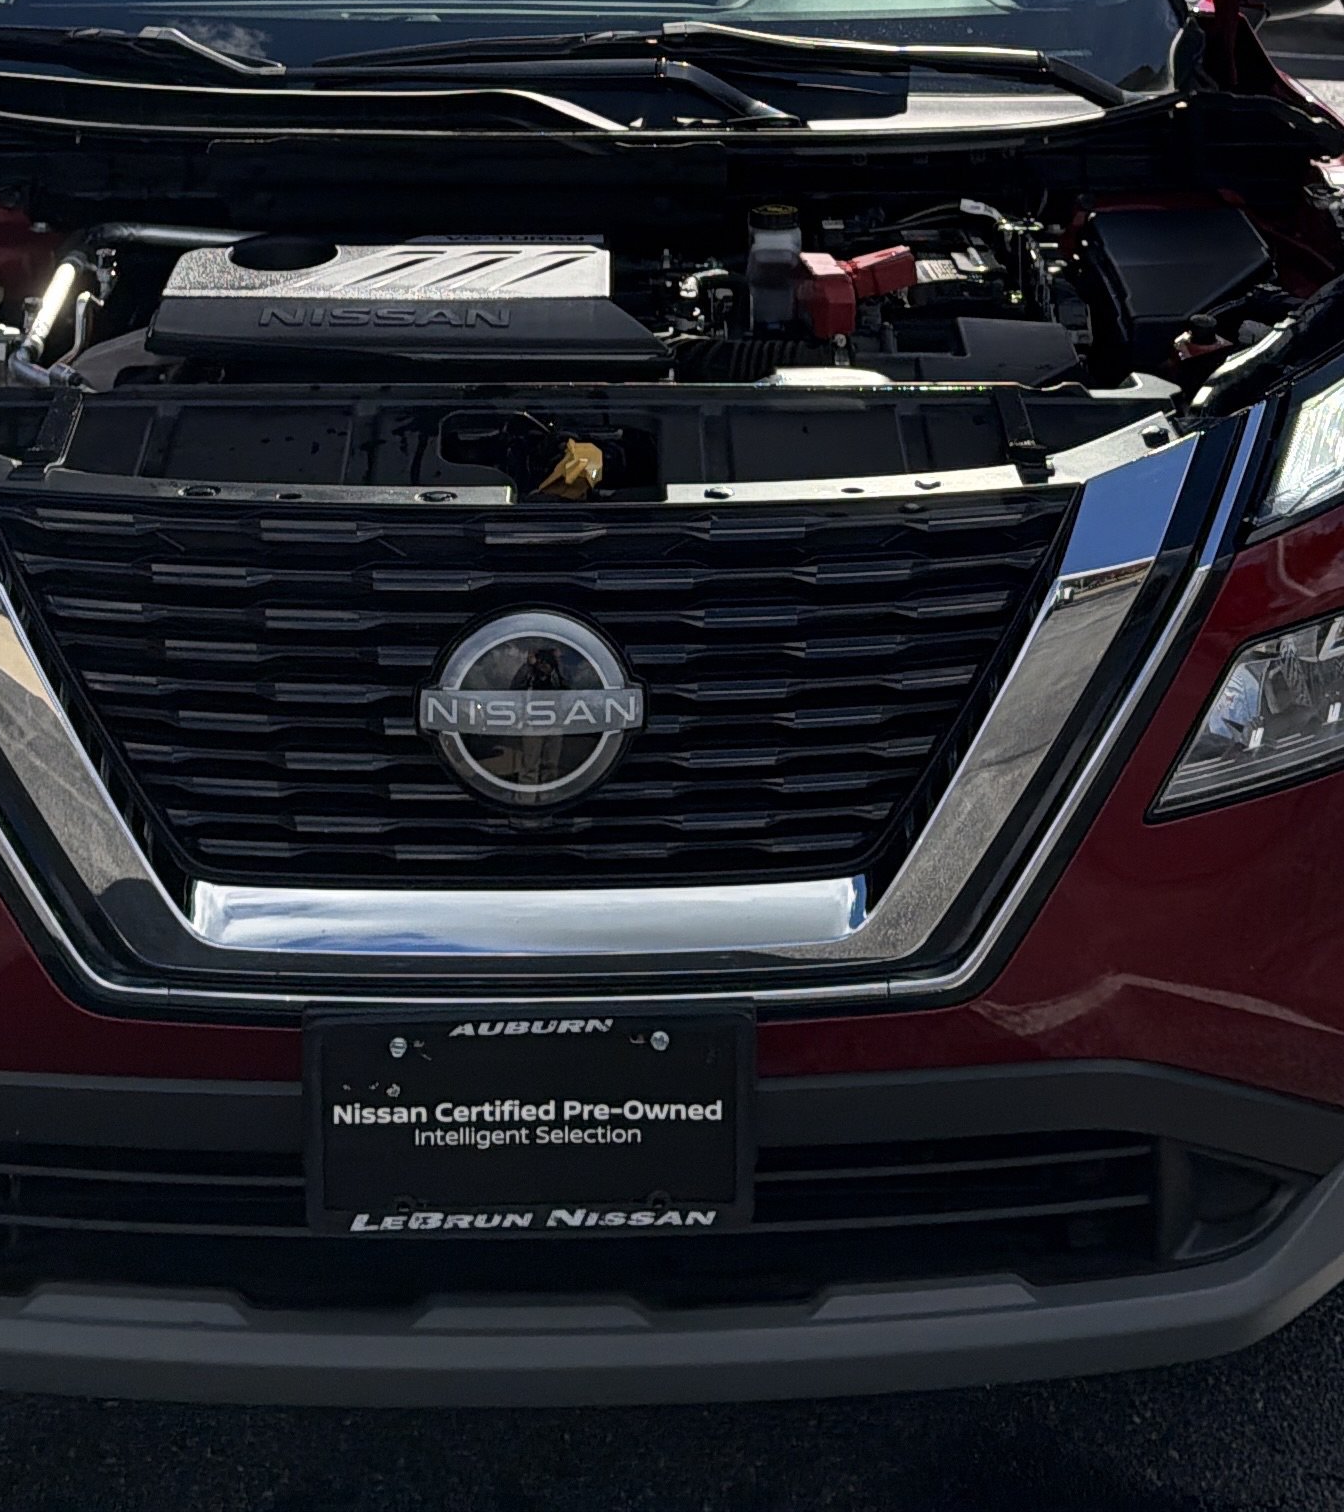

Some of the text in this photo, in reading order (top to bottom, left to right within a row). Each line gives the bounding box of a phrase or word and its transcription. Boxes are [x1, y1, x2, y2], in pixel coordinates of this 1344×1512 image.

[257, 304, 513, 329] NISSAN
[426, 696, 636, 726] NISSAN
[449, 1018, 614, 1037] AUBURN
[332, 1099, 723, 1125] Nissan Certified Pre-Owned
[414, 1125, 642, 1149] Intelligent Selection
